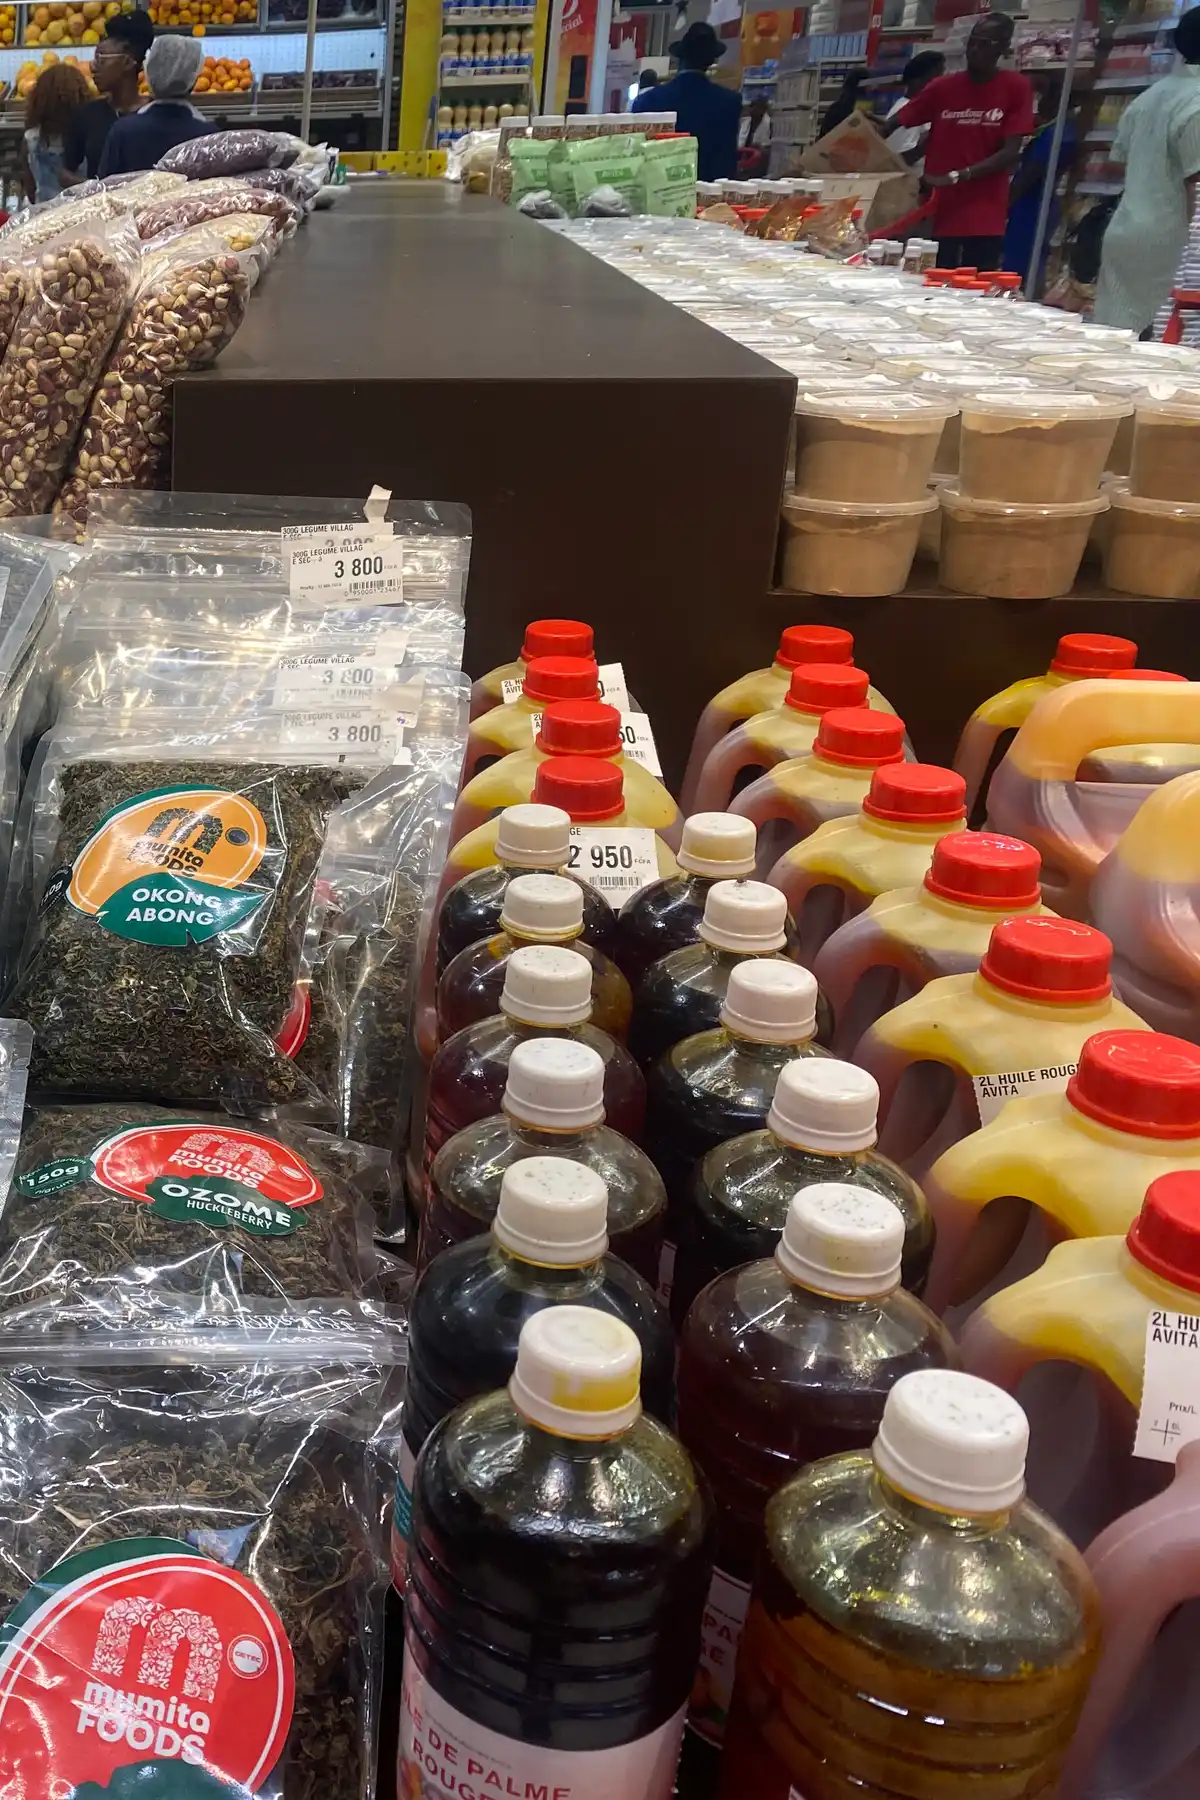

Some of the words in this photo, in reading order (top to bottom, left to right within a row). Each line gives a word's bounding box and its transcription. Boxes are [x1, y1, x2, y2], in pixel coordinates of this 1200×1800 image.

[330, 524, 354, 532] VILLAG
[292, 550, 308, 558] 300G
[310, 547, 338, 556] LEGUME
[339, 544, 363, 553] VILLAG
[334, 560, 344, 578] 3
[352, 556, 383, 576] 800
[300, 657, 329, 665] LEGUME
[331, 656, 355, 664] VILLAG
[504, 680, 513, 688] 2L
[506, 685, 523, 694] AVIT
[336, 710, 361, 720] VILLAG
[328, 726, 340, 742] 3
[346, 724, 382, 743] 800
[568, 845, 582, 868] 2
[590, 845, 633, 868] 950
[132, 888, 224, 910] OKONG
[125, 907, 216, 926] ABONG
[979, 1076, 995, 1087] 2L
[998, 1071, 1036, 1084] HUILE
[1040, 1063, 1079, 1080] ROUG
[982, 1084, 1019, 1098] AVITA
[168, 1154, 260, 1190] FOODS
[174, 1148, 266, 1181] mumita
[26, 1165, 80, 1188] 150g
[161, 1183, 293, 1228] OZOME
[186, 1199, 273, 1231] HUCKLEBERRY
[1152, 1312, 1171, 1328] 2L
[1152, 1328, 1199, 1348] AVITA
[234, 1650, 261, 1665] GETEC
[83, 1681, 210, 1735] mumita
[77, 1709, 205, 1766] FOODS
[428, 1727, 458, 1766] DE
